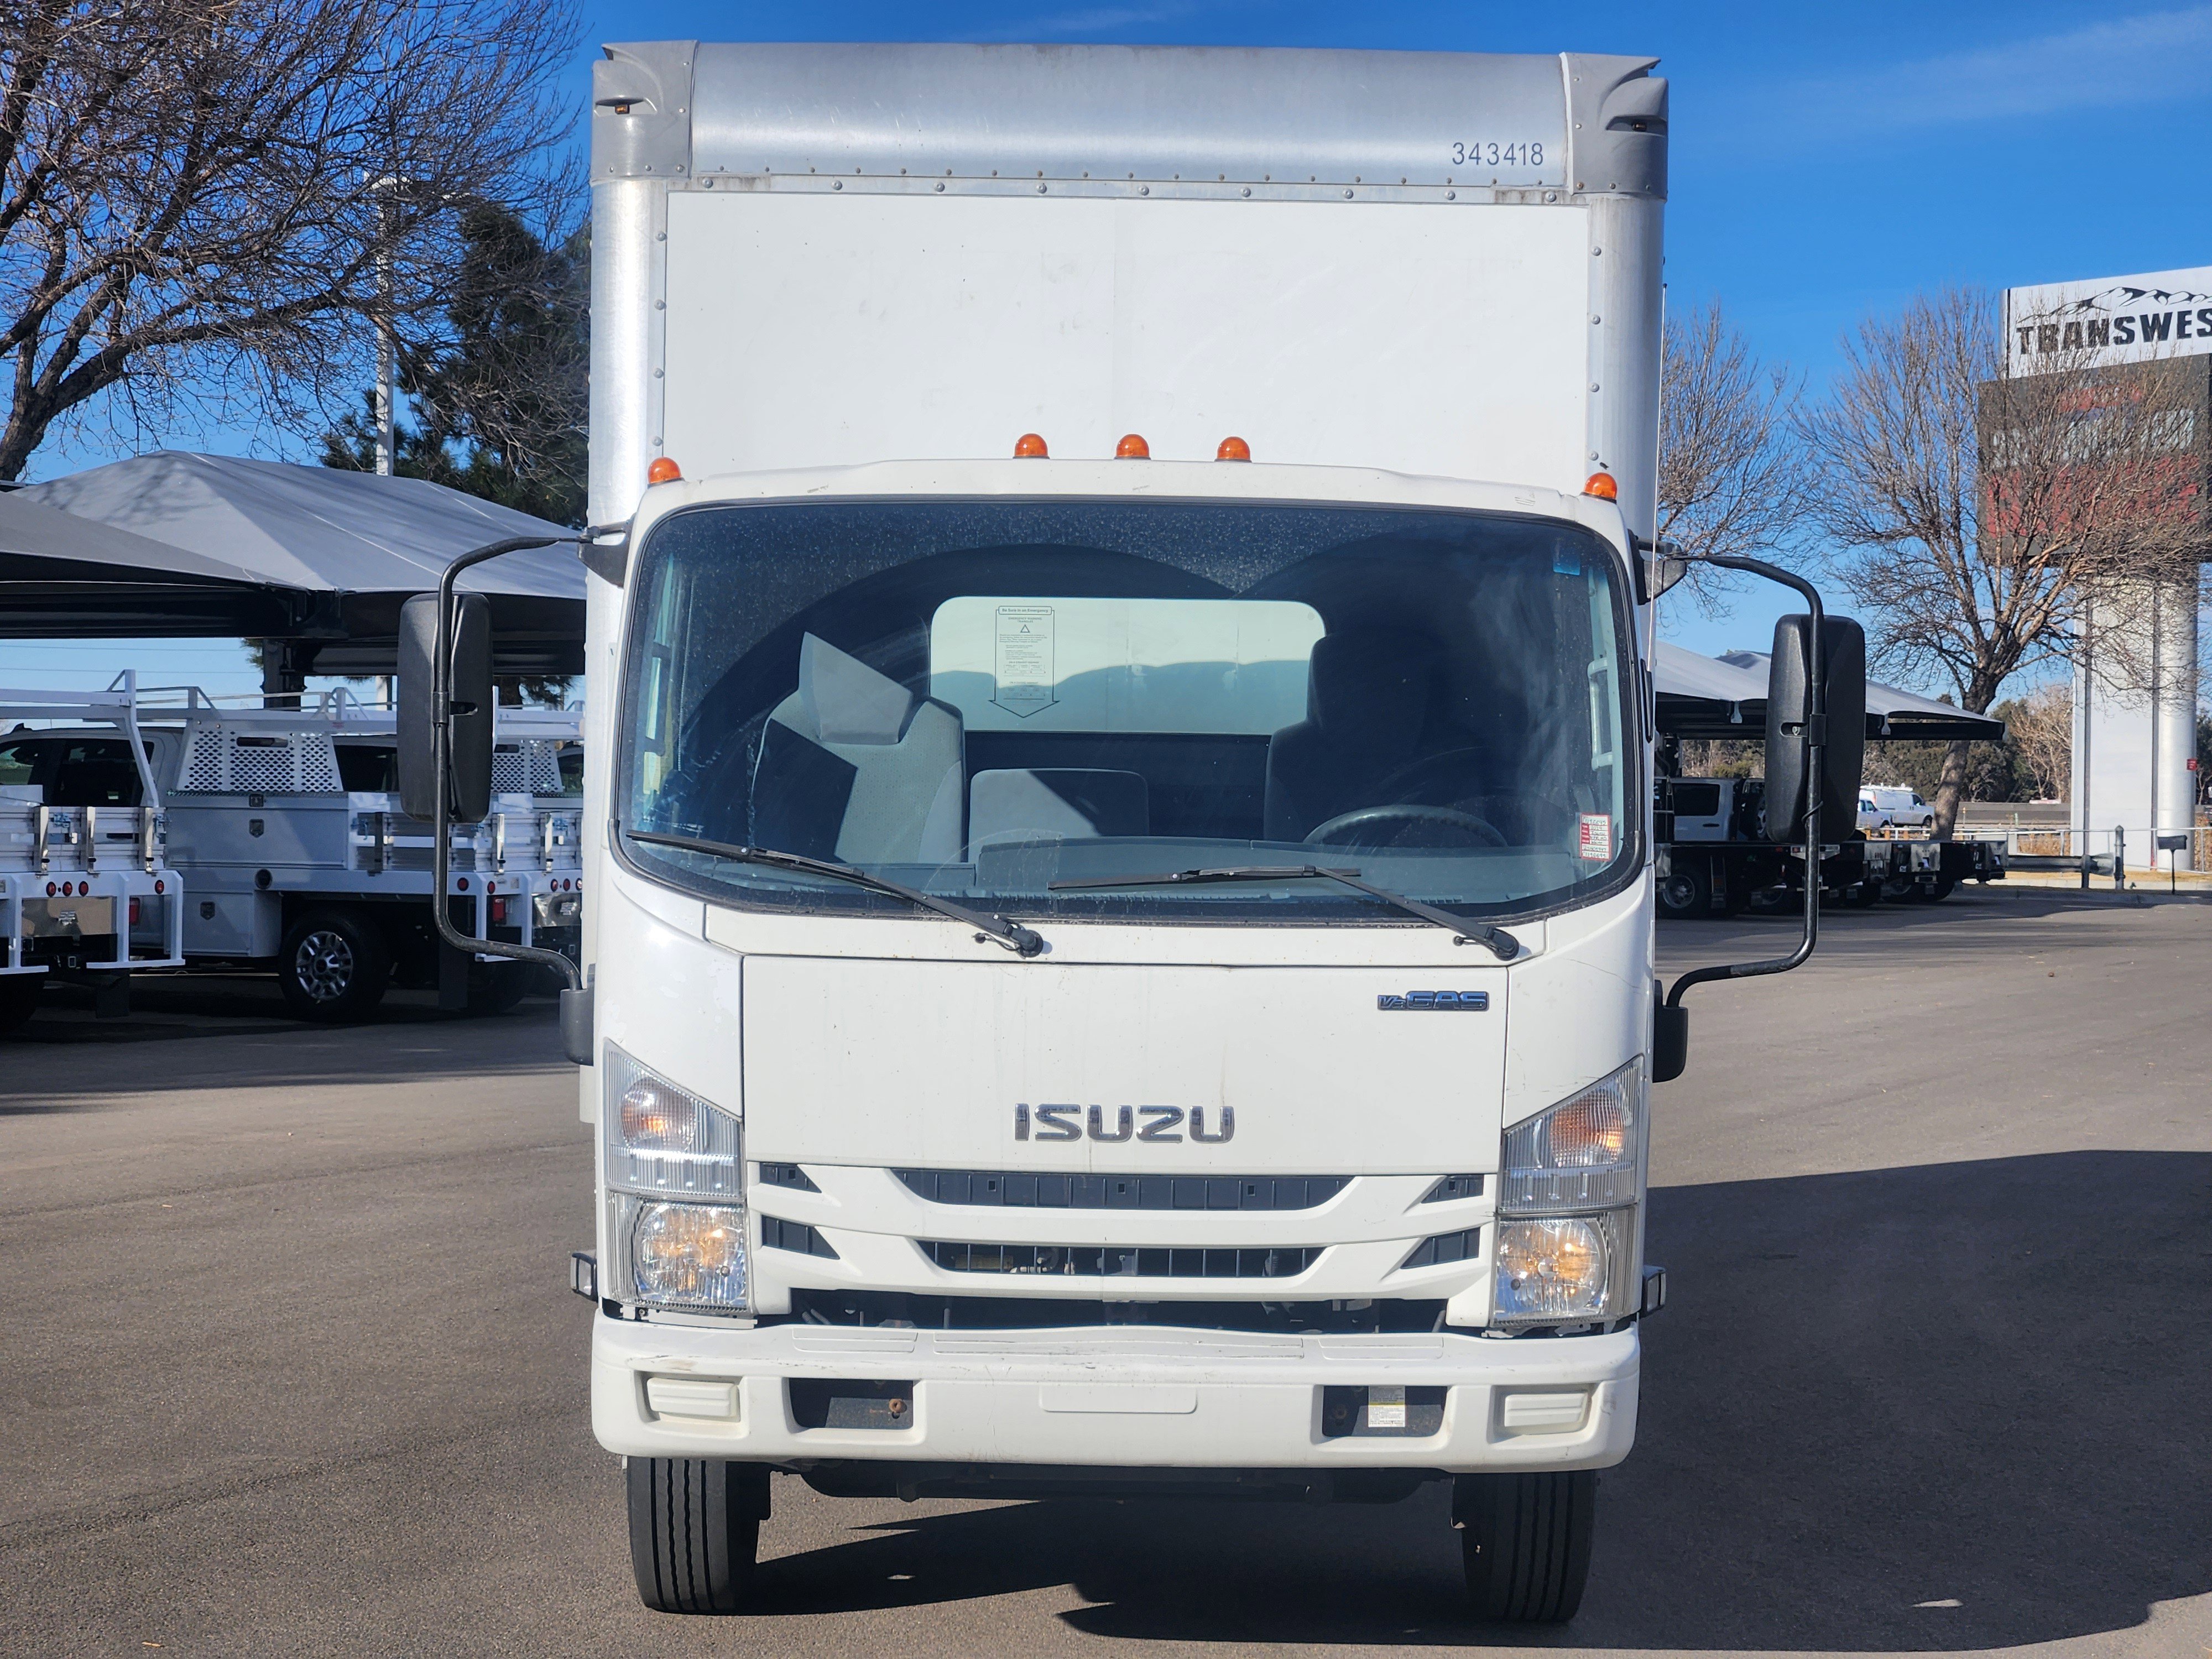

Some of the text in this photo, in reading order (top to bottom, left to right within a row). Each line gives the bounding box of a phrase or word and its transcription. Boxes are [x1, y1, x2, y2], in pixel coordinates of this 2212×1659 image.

[1452, 142, 1543, 165] 343418
[1406, 990, 1489, 1010] GAS
[1015, 1103, 1235, 1144] ISUZU
